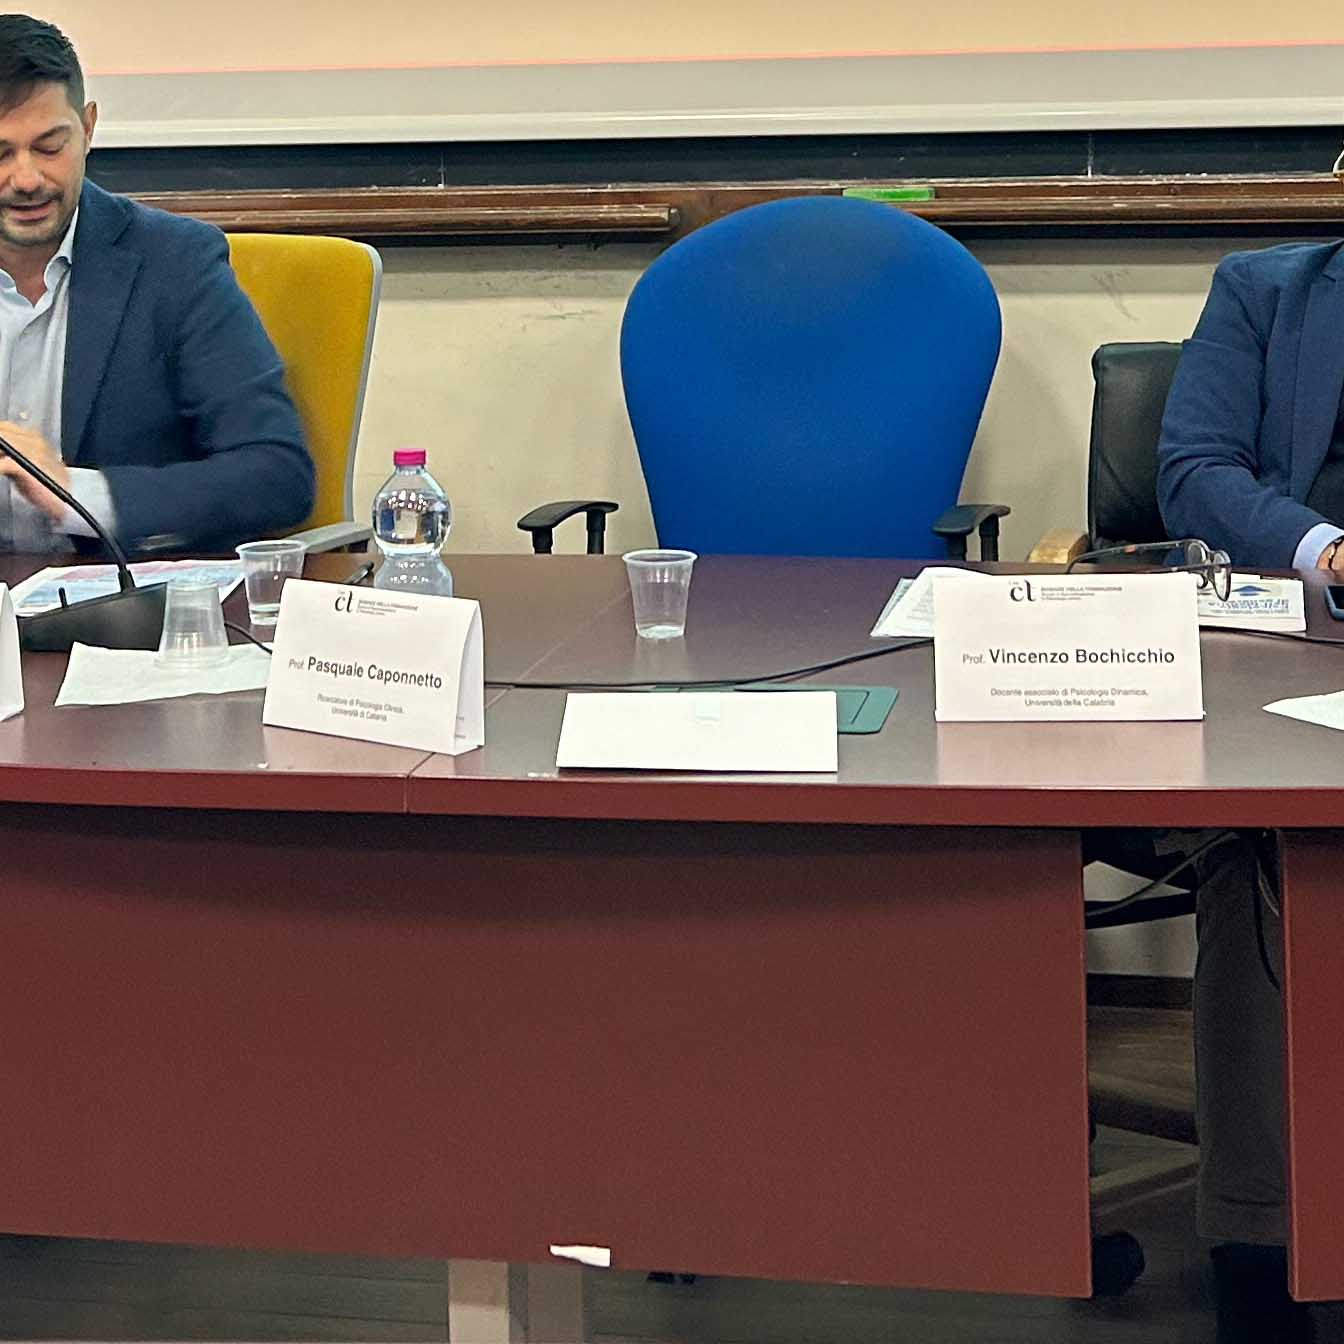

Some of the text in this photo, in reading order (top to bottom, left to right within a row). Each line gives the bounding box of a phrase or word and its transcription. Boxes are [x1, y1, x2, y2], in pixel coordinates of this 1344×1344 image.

[962, 648, 1175, 664] Prof. Vincenzo Bochicchio
[308, 656, 364, 678] Pasquale
[367, 664, 443, 689] Caponnetto
